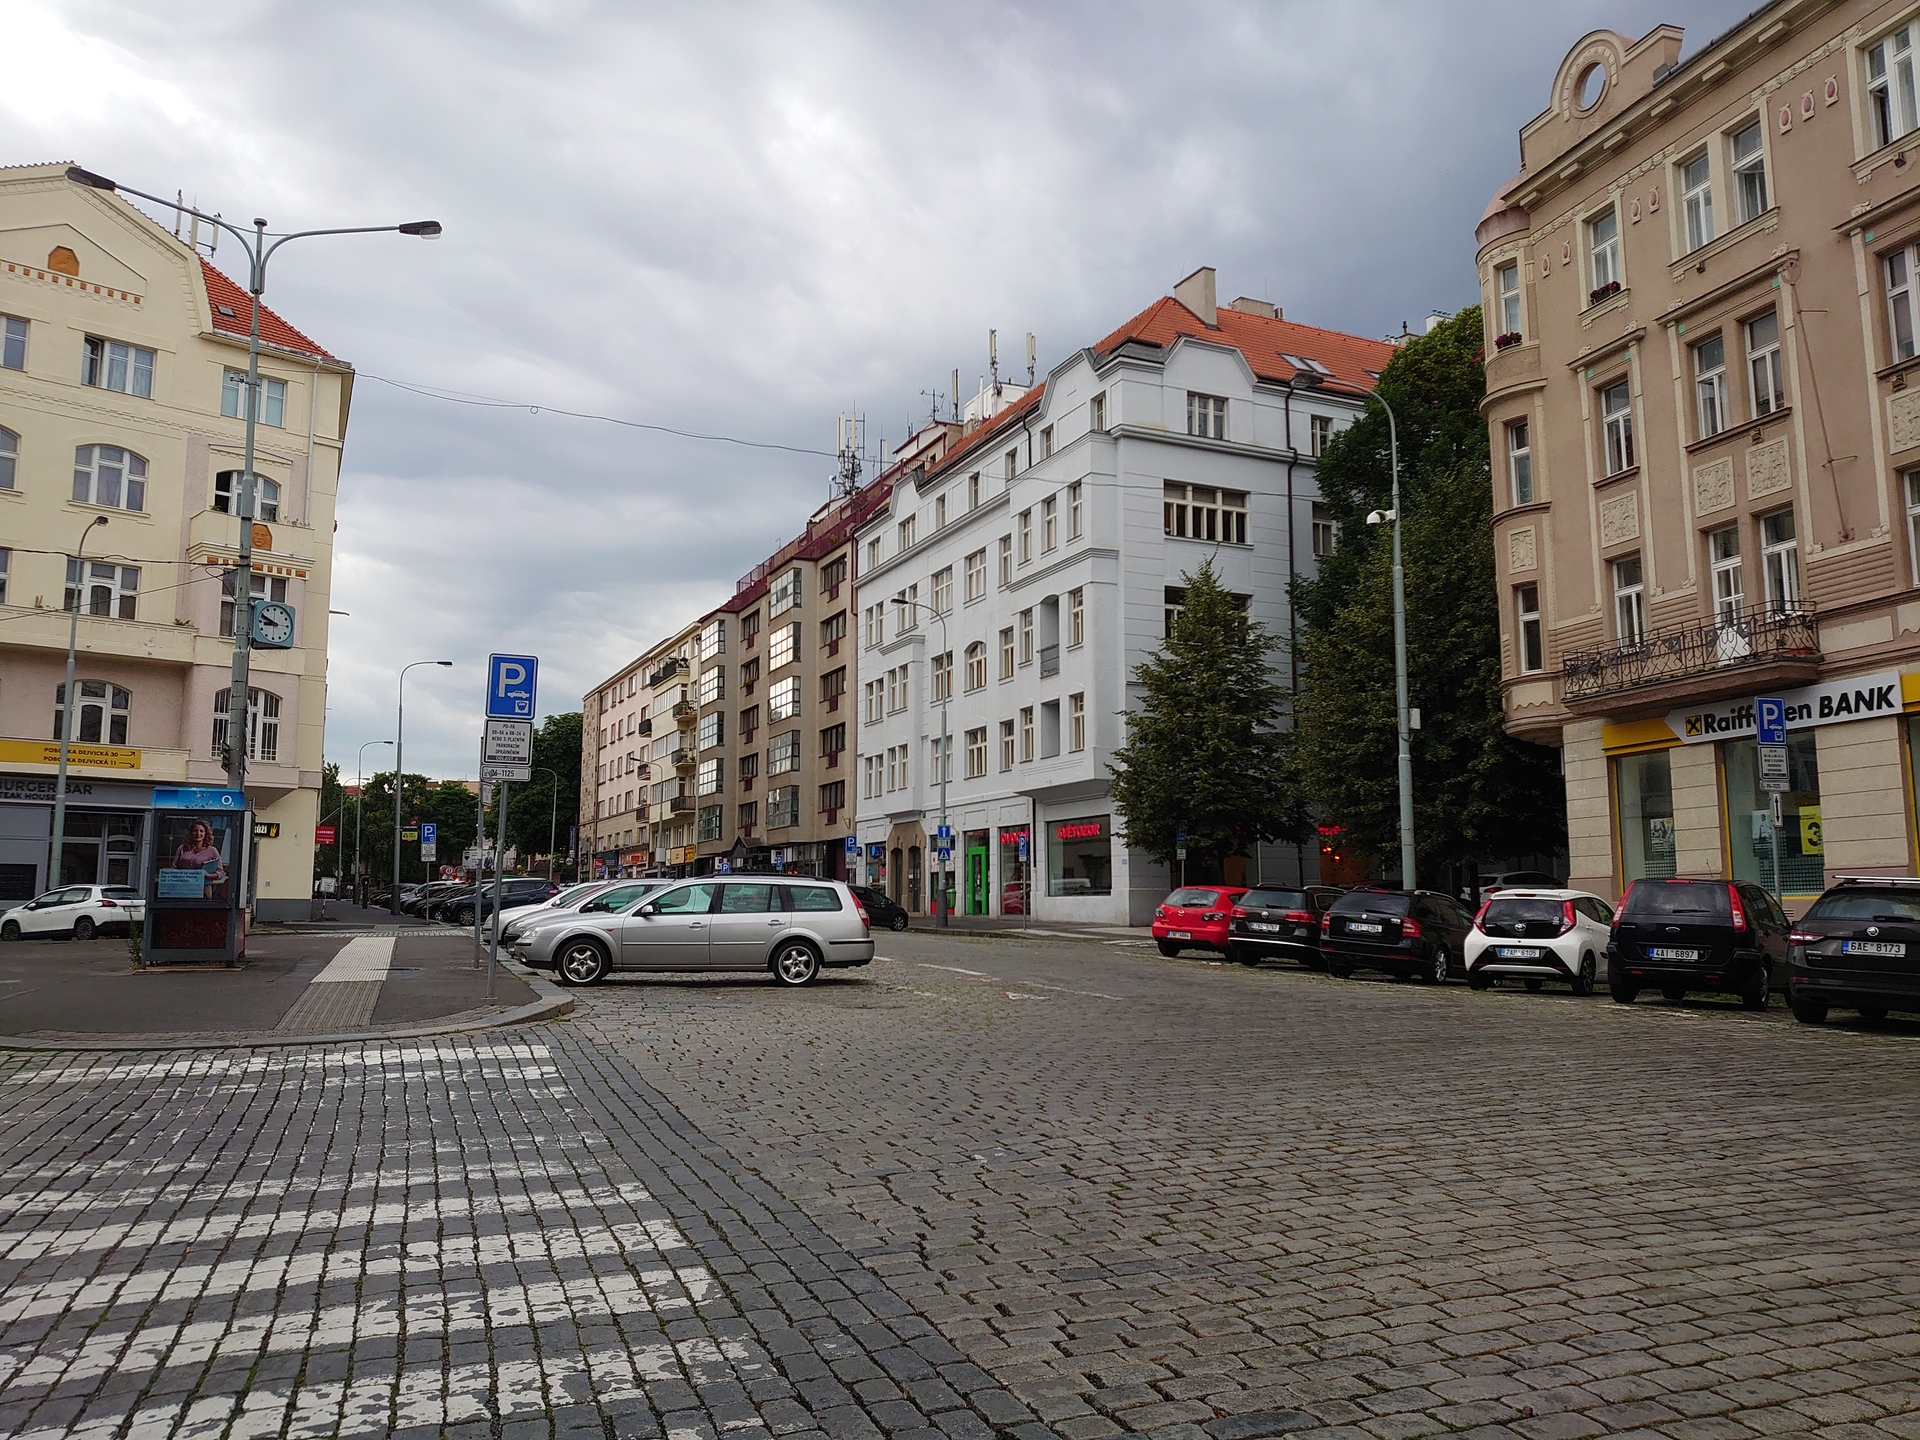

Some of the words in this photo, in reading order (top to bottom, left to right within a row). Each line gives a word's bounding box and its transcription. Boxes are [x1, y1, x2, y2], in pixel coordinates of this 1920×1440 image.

[498, 662, 526, 698] P
[1704, 702, 1812, 734] Raiffen
[1819, 684, 1895, 719] BANK
[1762, 703, 1779, 730] P
[44, 747, 76, 756] POBOKA
[78, 749, 109, 757] DEJVICKÁ
[65, 783, 92, 795] BAR
[24, 792, 56, 801] HOUSE
[1850, 942, 1869, 952] 6AE
[1876, 944, 1901, 953] 8173
[1655, 949, 1669, 957] 4AI
[1675, 950, 1694, 958] 6897
